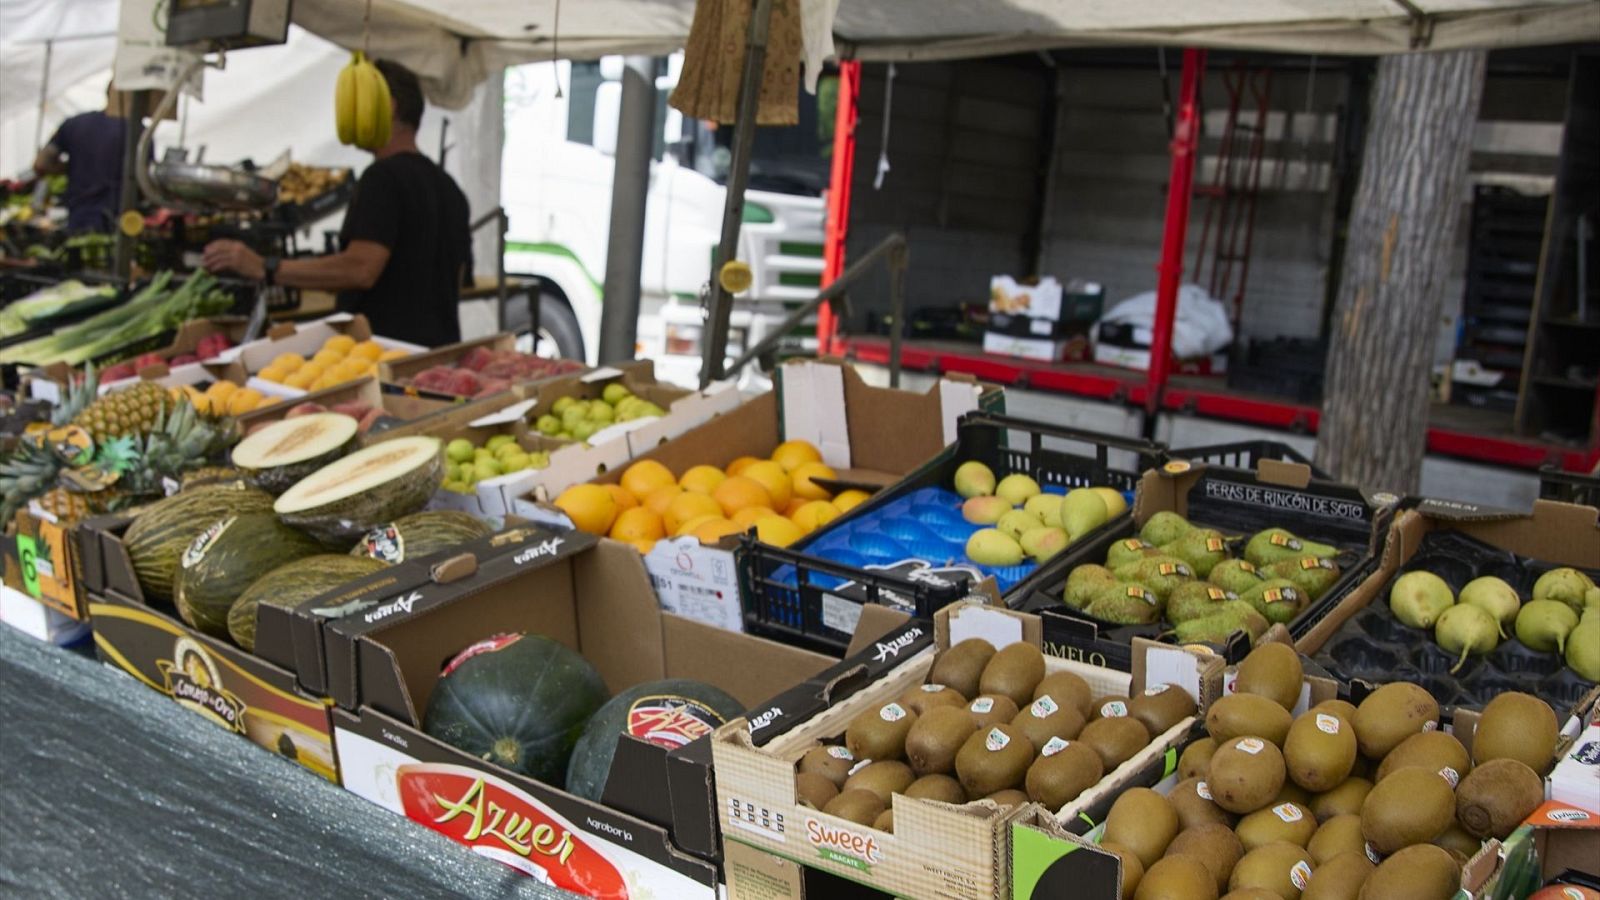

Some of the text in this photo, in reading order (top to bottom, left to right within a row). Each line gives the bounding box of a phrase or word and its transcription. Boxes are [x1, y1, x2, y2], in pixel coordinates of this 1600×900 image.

[1206, 482, 1363, 518] PERAS DE RINCÓN DE SOTO
[22, 548, 37, 582] 6
[872, 627, 924, 663] Azuer
[215, 697, 234, 720] Oro
[633, 703, 710, 741] Azu
[433, 776, 575, 865] Azuer
[807, 819, 878, 862] Sweet
[829, 852, 859, 868] ABACATE
